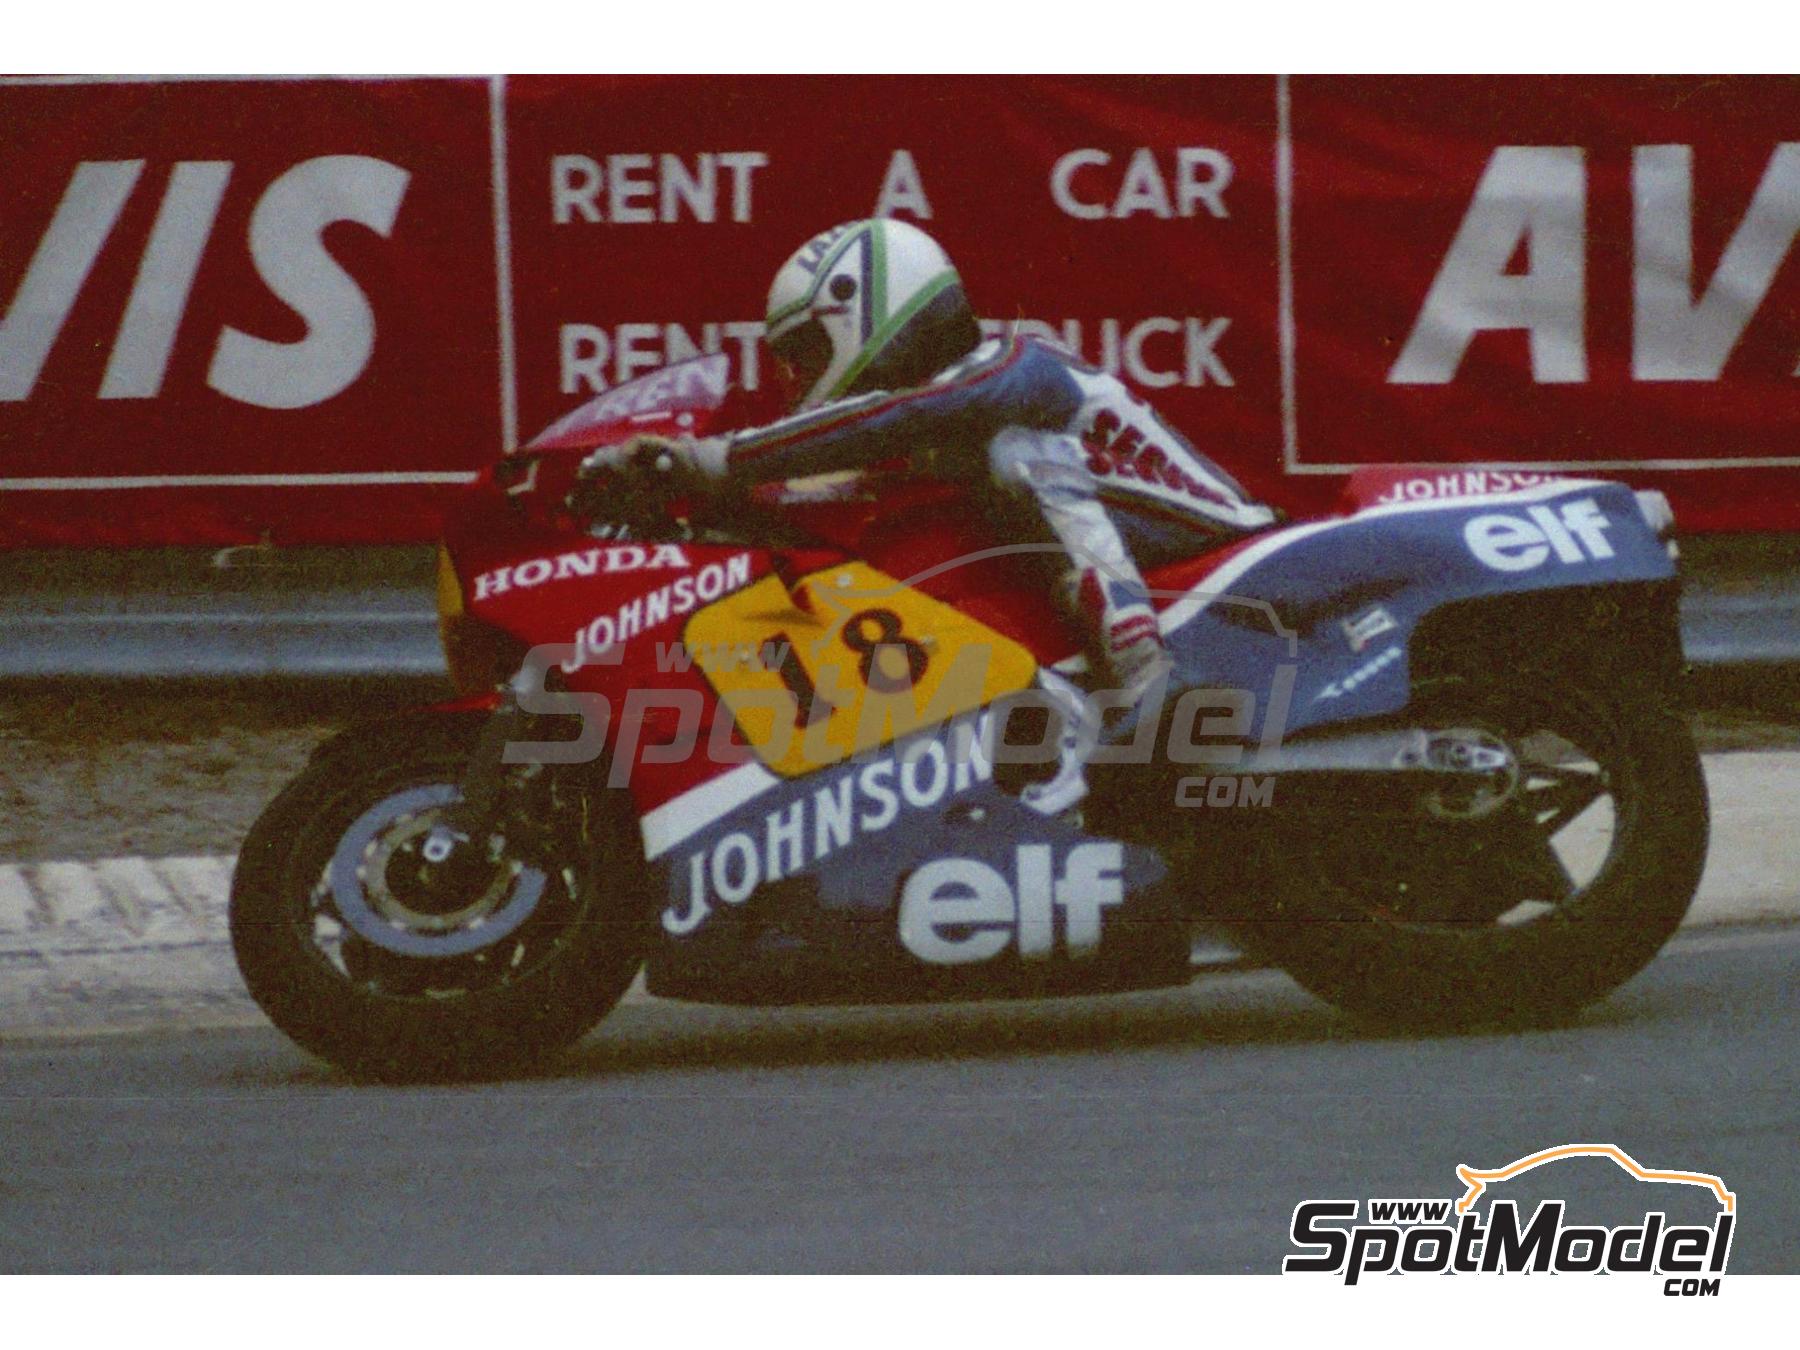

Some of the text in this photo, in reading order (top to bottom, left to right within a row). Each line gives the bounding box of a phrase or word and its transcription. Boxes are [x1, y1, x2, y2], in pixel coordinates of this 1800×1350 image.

[550, 147, 1233, 224] RENT A CAR
[1386, 141, 1800, 384] AV
[558, 320, 768, 394] RENT
[473, 543, 691, 601] HONDA
[1463, 497, 1616, 572] elf
[561, 552, 750, 674] JOHNSON
[759, 606, 930, 730] 18
[661, 708, 996, 937] JOHNSON
[899, 841, 1124, 966] elf
